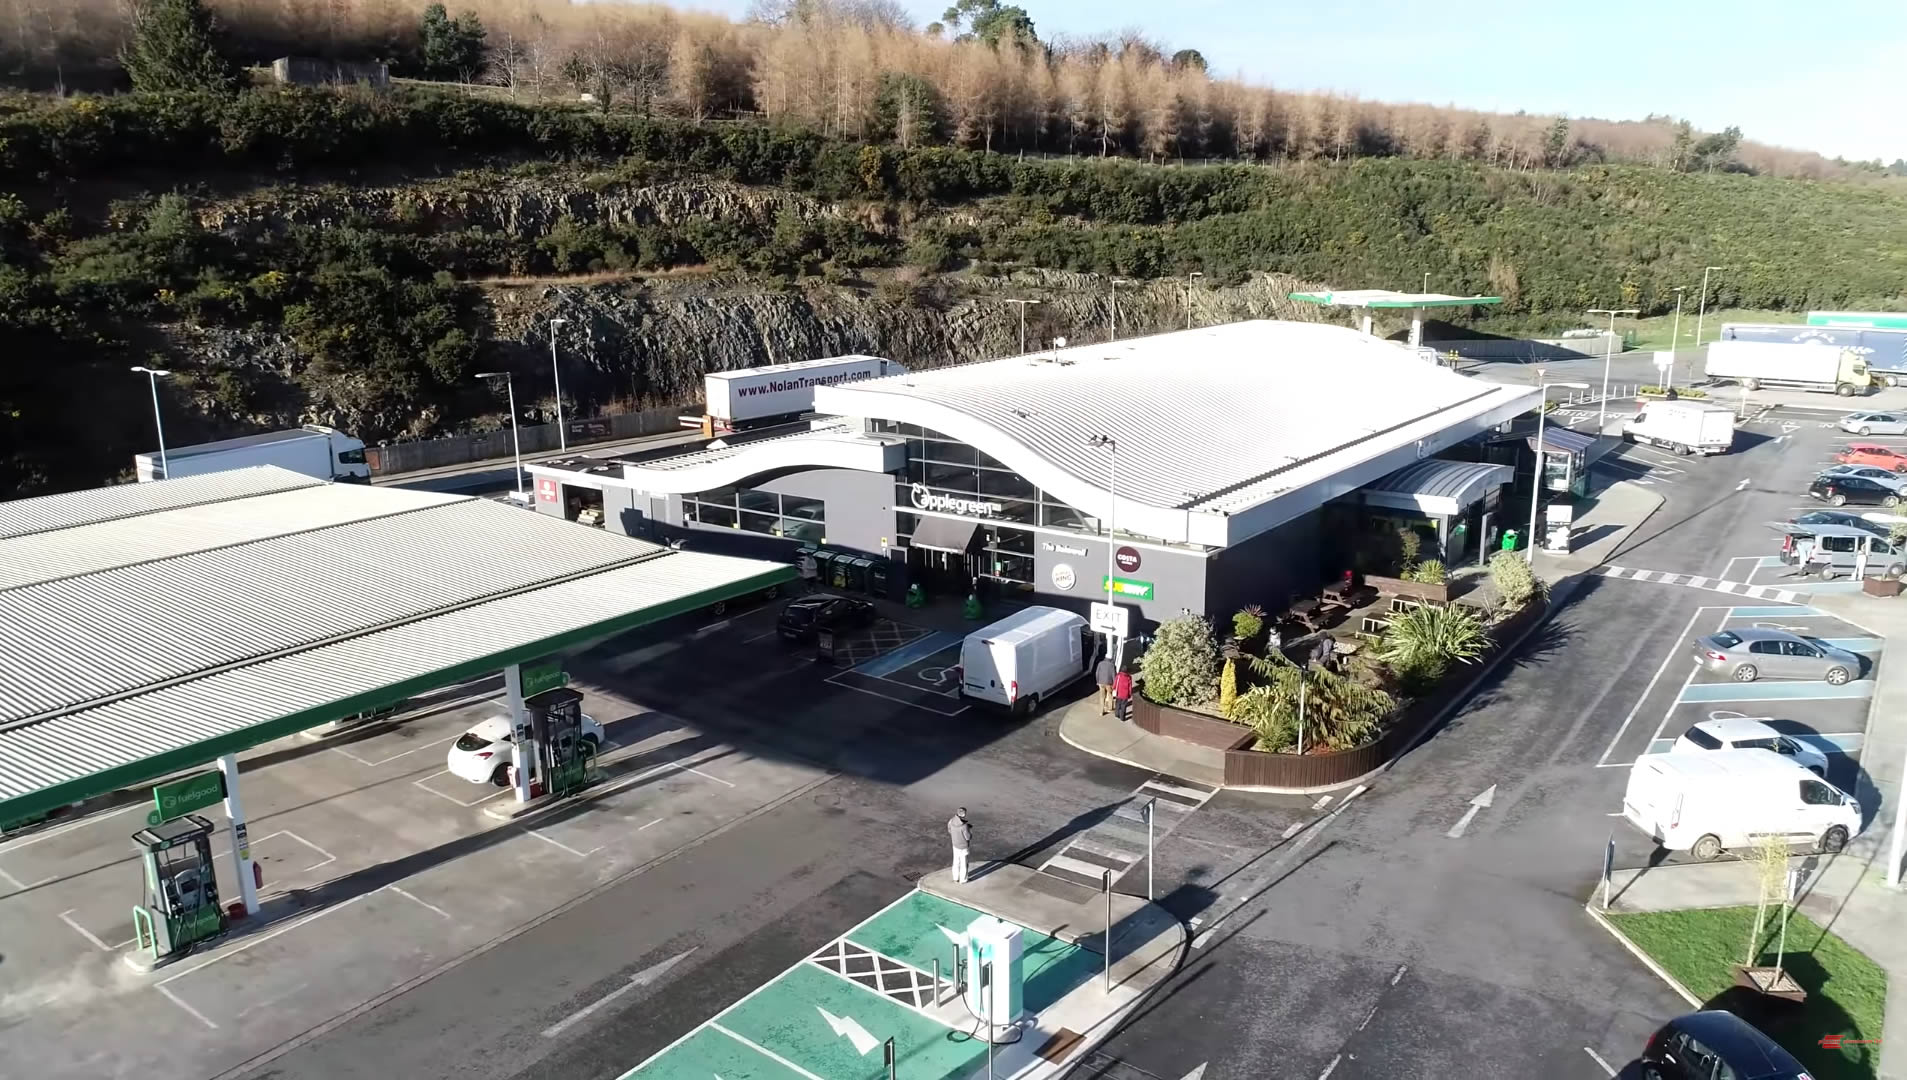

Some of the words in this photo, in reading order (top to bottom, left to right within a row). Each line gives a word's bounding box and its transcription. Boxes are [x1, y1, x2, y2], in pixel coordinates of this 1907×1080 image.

[920, 493, 993, 515] applegreen
[1117, 554, 1138, 564] COSTA
[1096, 609, 1121, 622] EXIT
[177, 784, 217, 803] fuelgood
